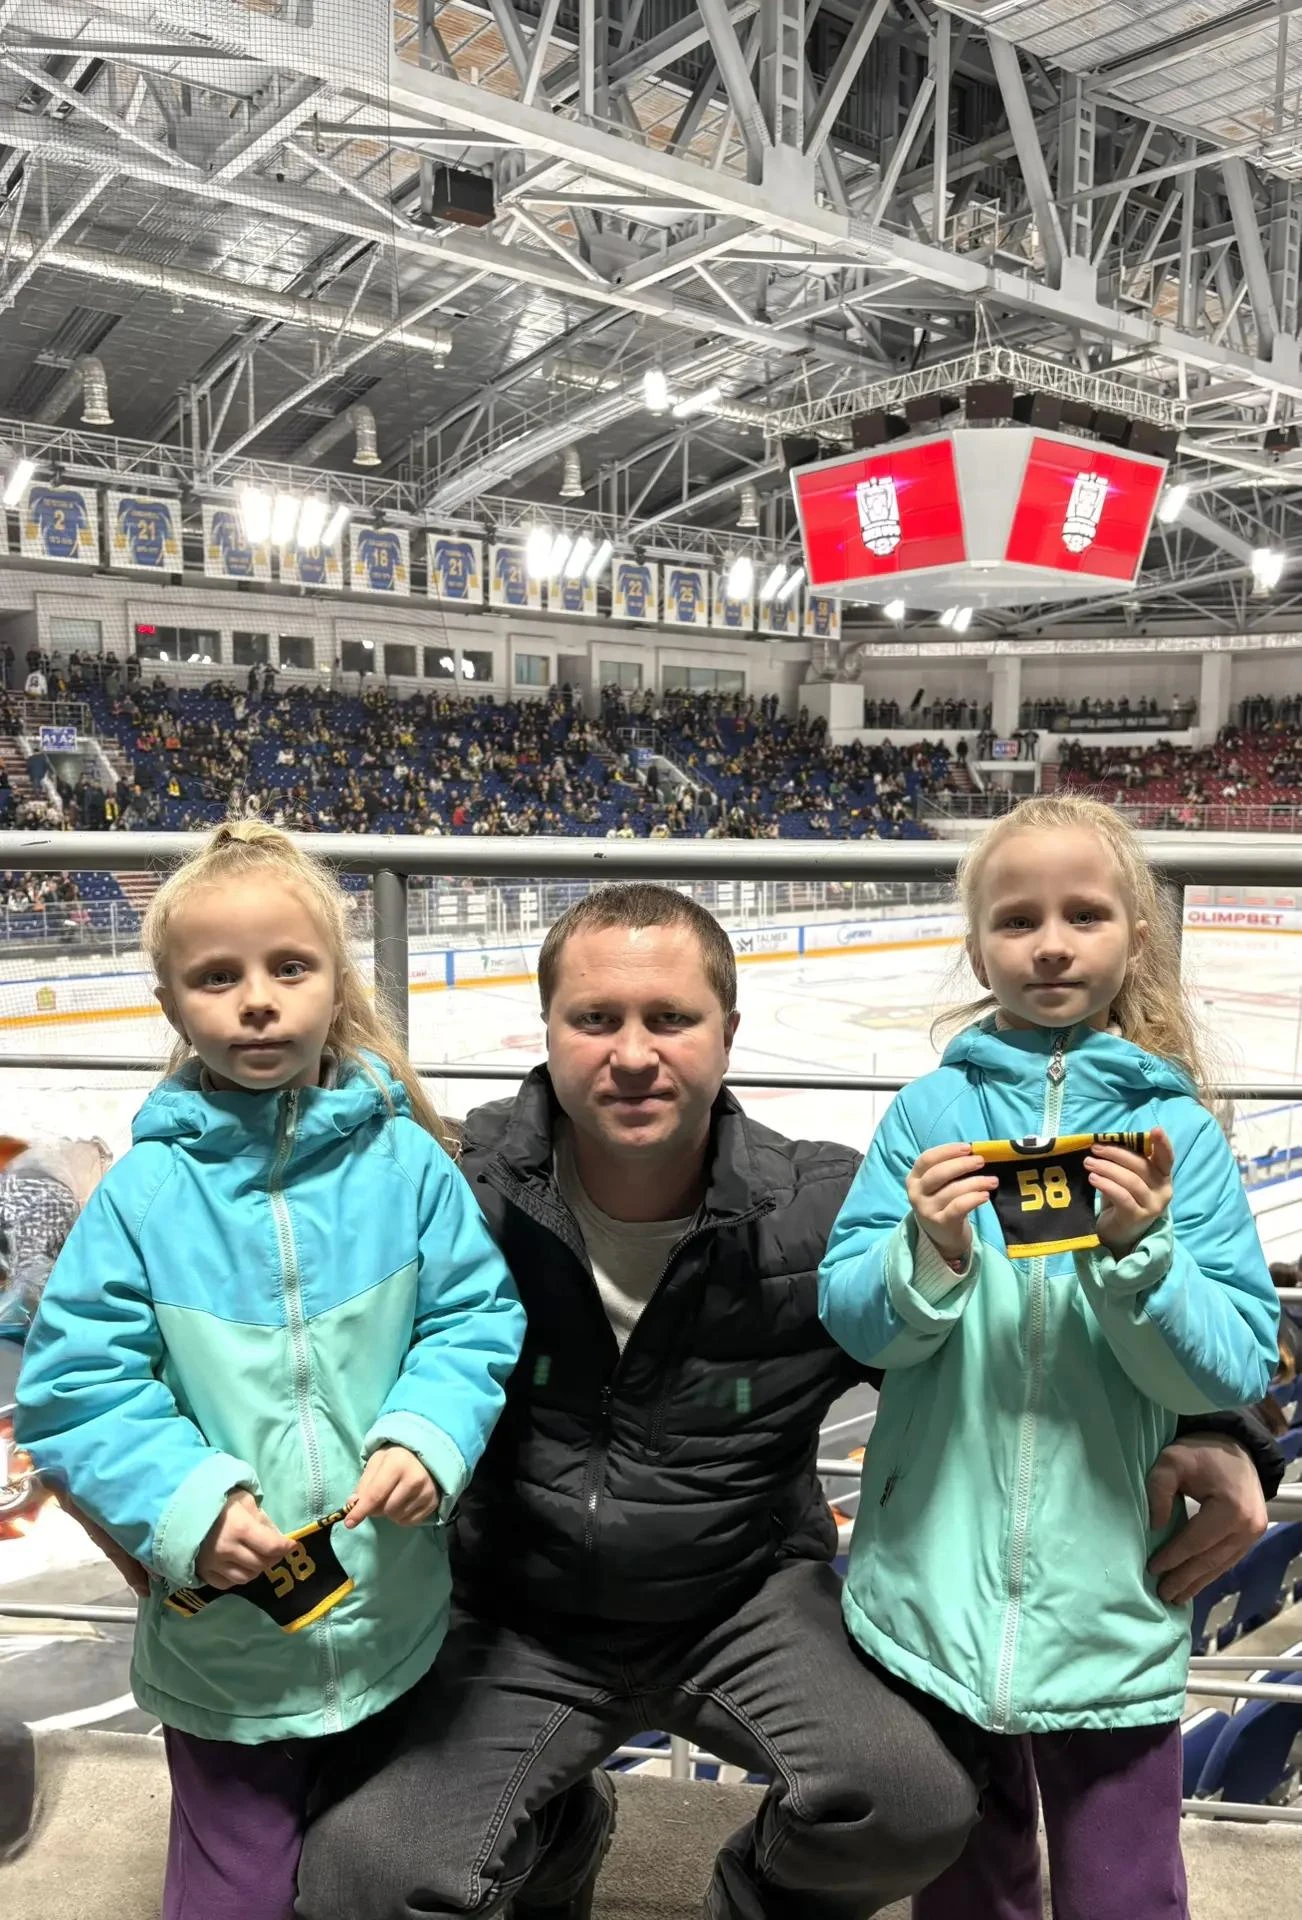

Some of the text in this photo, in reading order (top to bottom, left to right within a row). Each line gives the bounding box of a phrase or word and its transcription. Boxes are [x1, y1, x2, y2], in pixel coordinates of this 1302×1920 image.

[54, 509, 66, 530] 2
[137, 519, 156, 541] 21
[448, 558, 463, 576] 21
[1188, 911, 1284, 925] OLIMPBET
[1016, 1166, 1071, 1212] 58
[264, 1541, 316, 1599] 58
